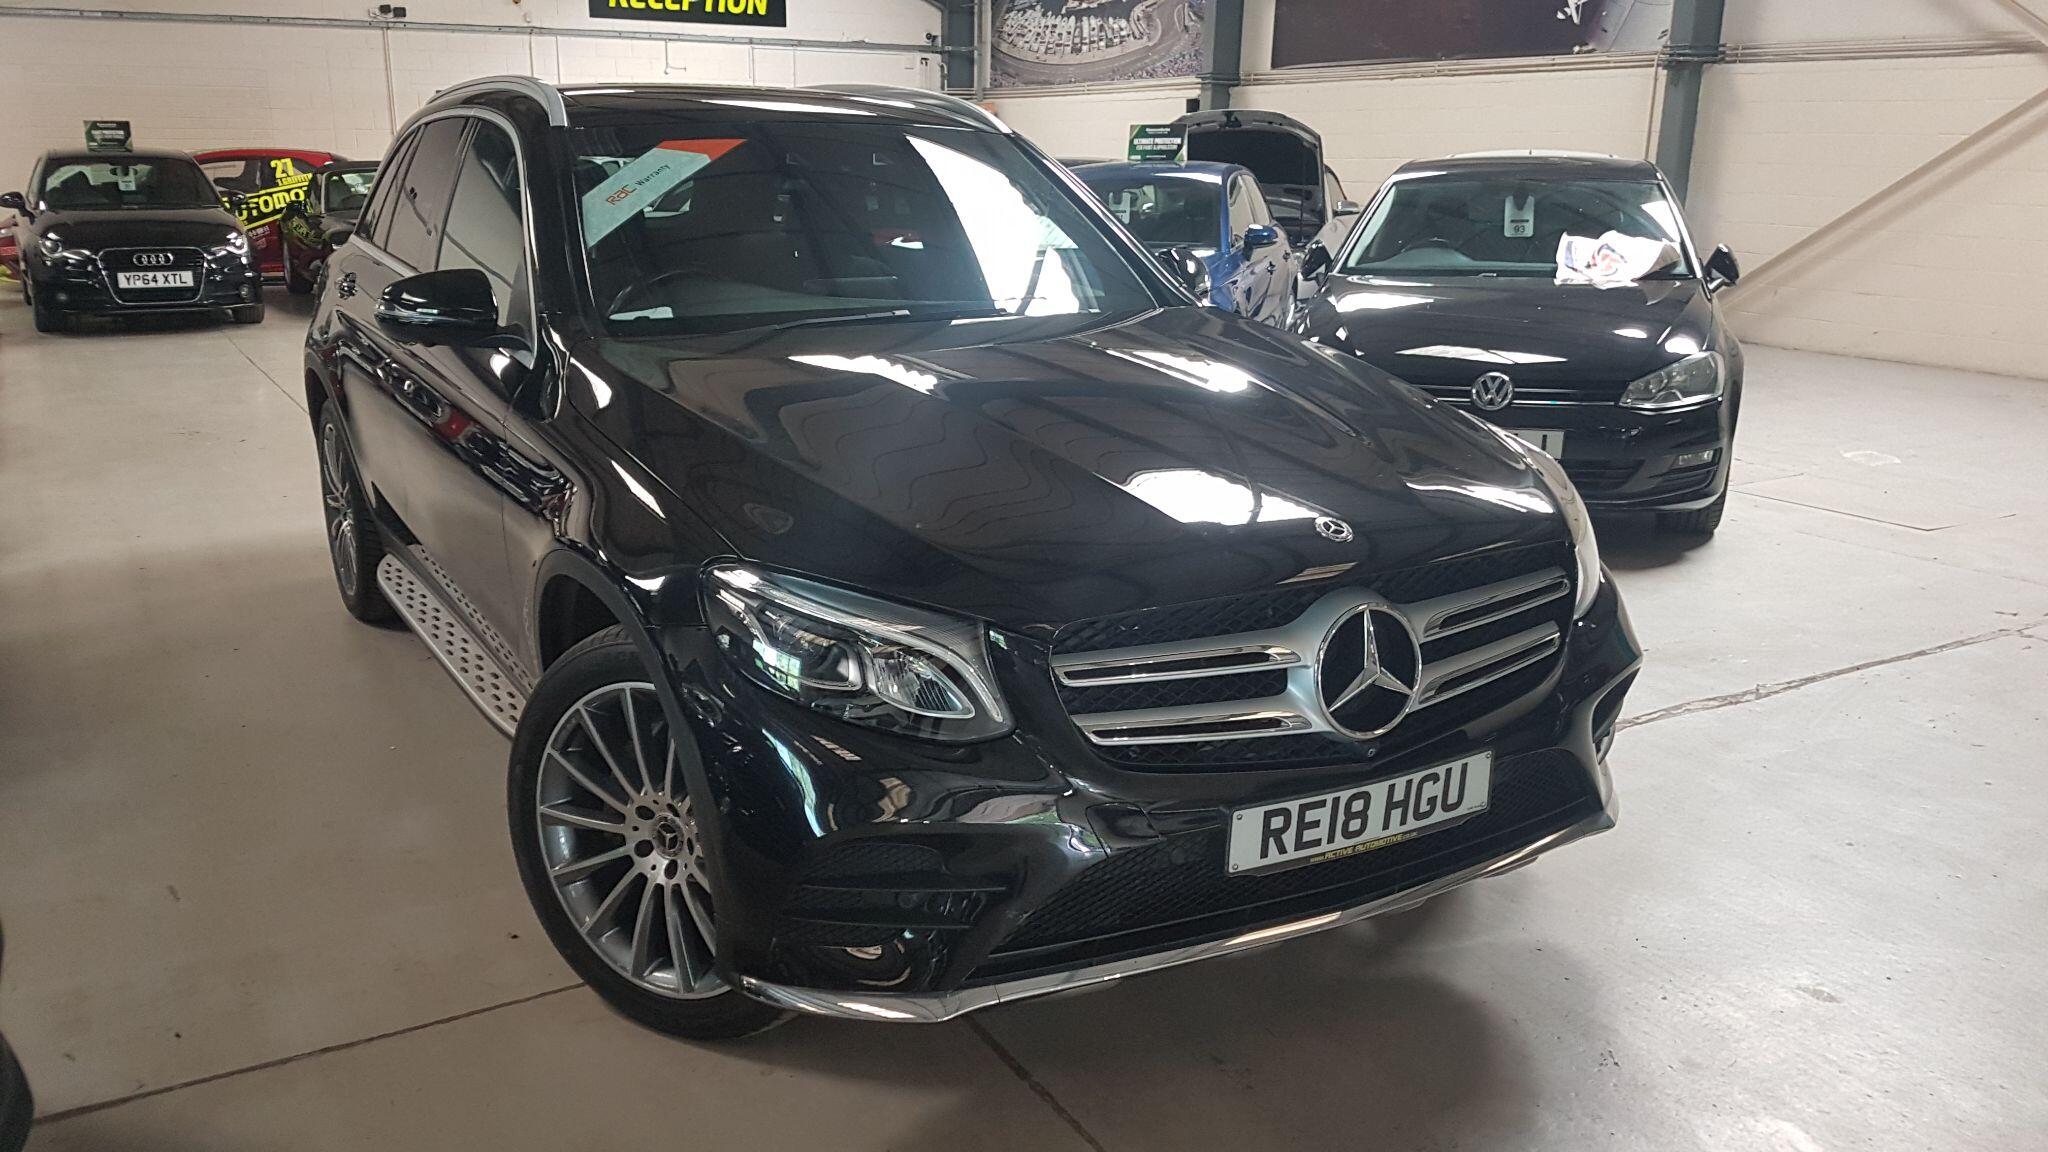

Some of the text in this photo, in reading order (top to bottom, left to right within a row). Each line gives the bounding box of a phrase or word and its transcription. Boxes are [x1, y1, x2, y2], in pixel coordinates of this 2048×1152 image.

[635, 163, 671, 187] Warranty
[123, 273, 188, 287] YP64 XTL
[1260, 762, 1469, 860] RE18 HGU
